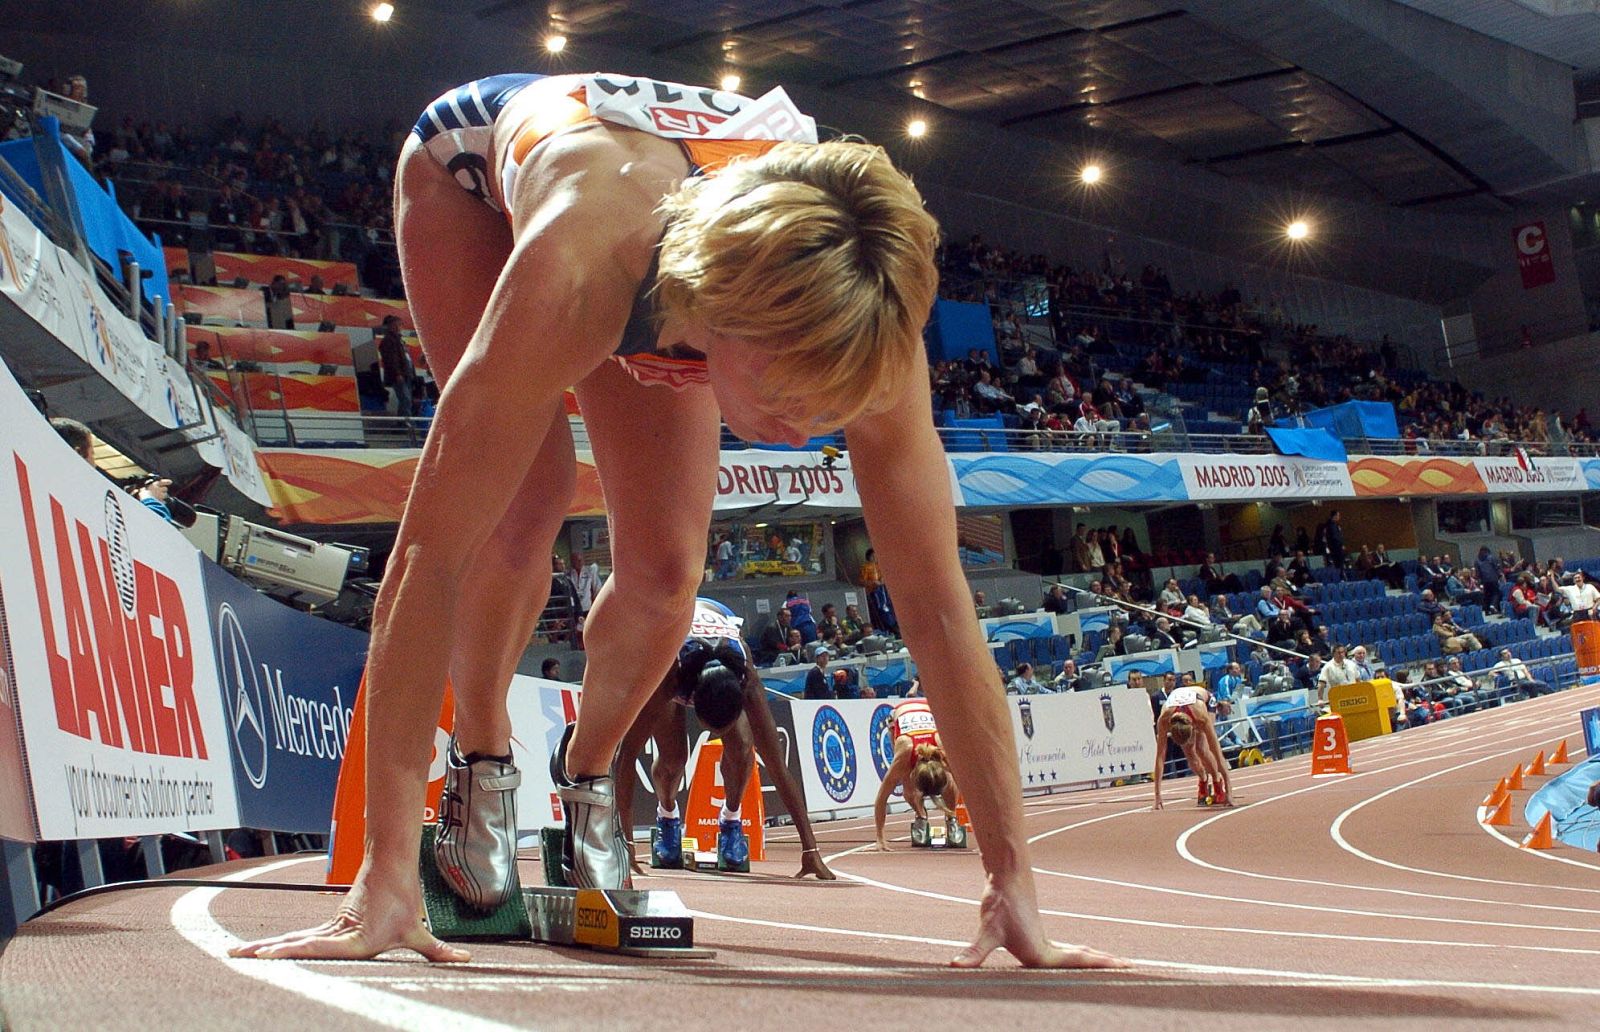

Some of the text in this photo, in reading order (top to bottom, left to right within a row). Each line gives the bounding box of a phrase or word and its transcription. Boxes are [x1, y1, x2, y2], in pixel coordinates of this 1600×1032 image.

[1518, 226, 1545, 254] C
[717, 465, 844, 494] DRID 2005
[1194, 465, 1290, 488] MADRID 2005
[1485, 466, 1523, 483] MADRID
[13, 450, 209, 760] LANIER
[1323, 727, 1337, 751] 3
[91, 754, 141, 819] document
[140, 764, 182, 818] solution
[577, 907, 608, 930] SEIKO
[630, 926, 682, 939] SEIKO
